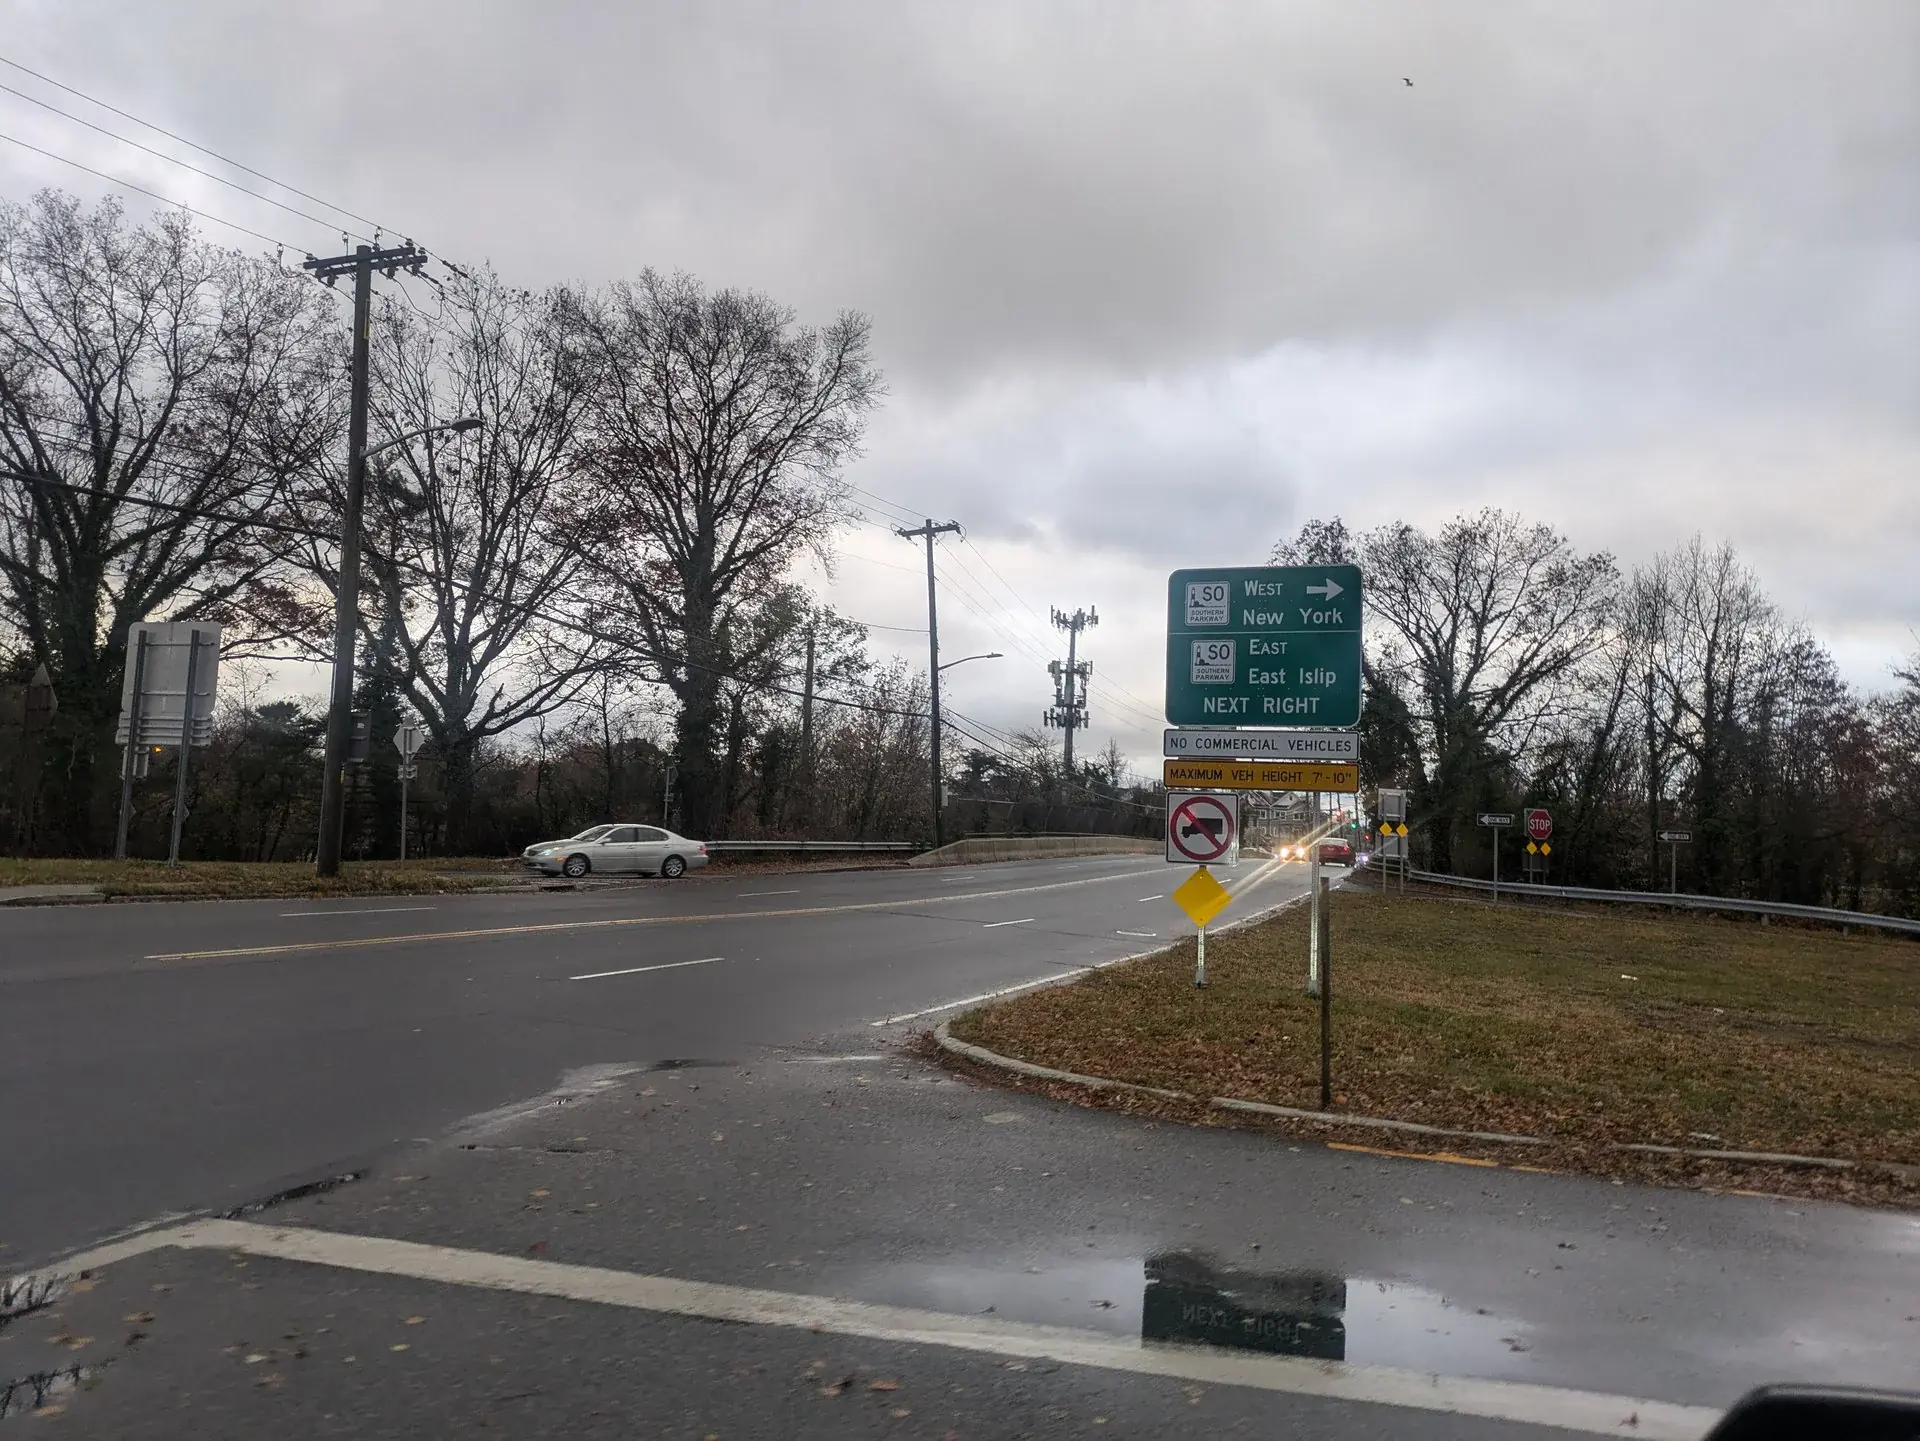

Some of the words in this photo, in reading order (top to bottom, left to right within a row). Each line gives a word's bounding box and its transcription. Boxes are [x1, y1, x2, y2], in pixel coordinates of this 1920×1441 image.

[1202, 586, 1225, 602] SO
[1244, 580, 1284, 596] WEST
[1189, 615, 1225, 623] PARKWAY
[1243, 609, 1284, 625] New
[1299, 607, 1344, 624] York
[1208, 644, 1230, 660] SO
[1249, 639, 1288, 655] EAST
[1249, 668, 1286, 685] East
[1299, 667, 1337, 688] Islip
[1203, 697, 1250, 714] NEXT
[1263, 697, 1320, 714] RIGHT
[1170, 737, 1188, 749] NO
[1195, 738, 1278, 750] COMMERCIAL
[1288, 739, 1352, 752] VEHICLES
[1170, 768, 1223, 781] MAXIMUM
[1231, 770, 1254, 781] VEH
[1262, 771, 1303, 783] HEIGHT
[1529, 818, 1551, 831] STOP
